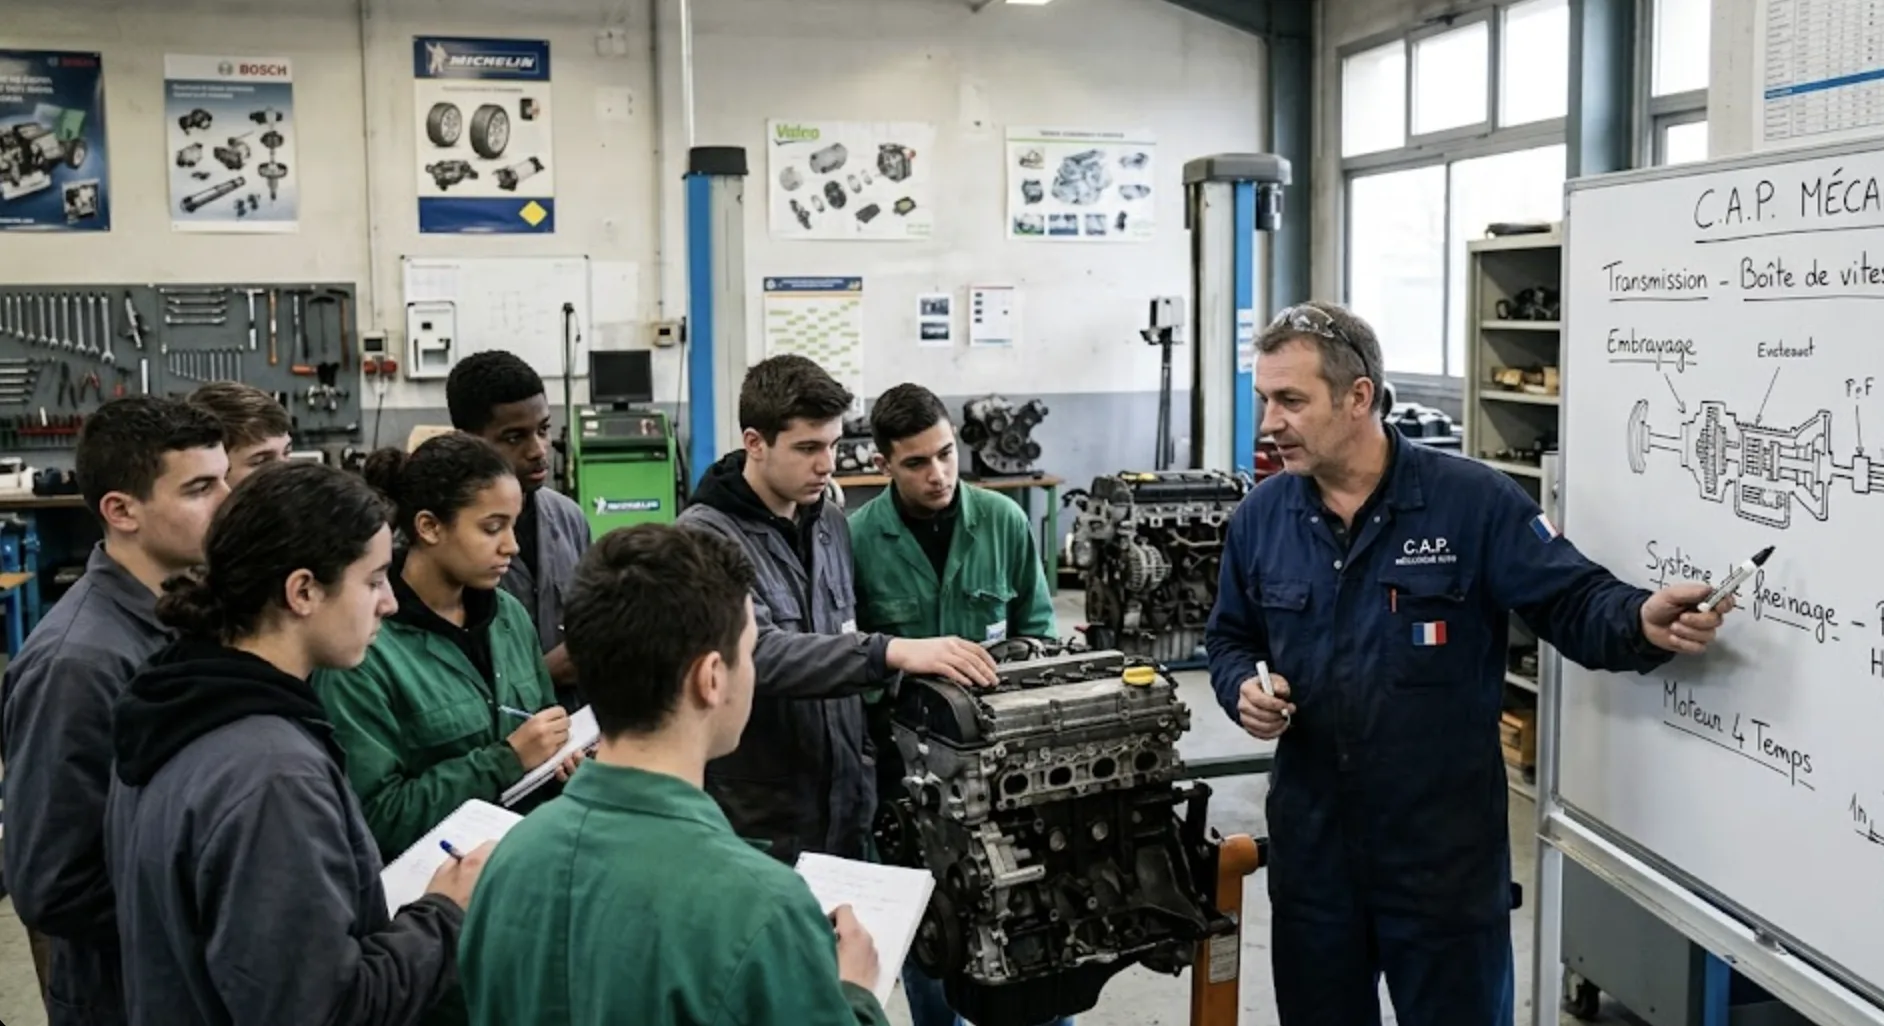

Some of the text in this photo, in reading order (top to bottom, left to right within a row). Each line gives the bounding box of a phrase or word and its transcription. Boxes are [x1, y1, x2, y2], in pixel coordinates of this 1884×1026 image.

[239, 63, 288, 76] BOSCH
[449, 54, 535, 69] MICHELIN
[1693, 179, 1776, 230] C.A.P.
[1601, 259, 1709, 292] Transmission
[1740, 254, 1796, 290] Boîte
[1804, 258, 1830, 288] de
[1606, 326, 1698, 374] Embrayage
[1402, 537, 1450, 555] C.A.P.
[1645, 539, 1713, 590] Système
[1751, 568, 1839, 644] freinage
[1662, 678, 1813, 787] Moteur 4 Temps
